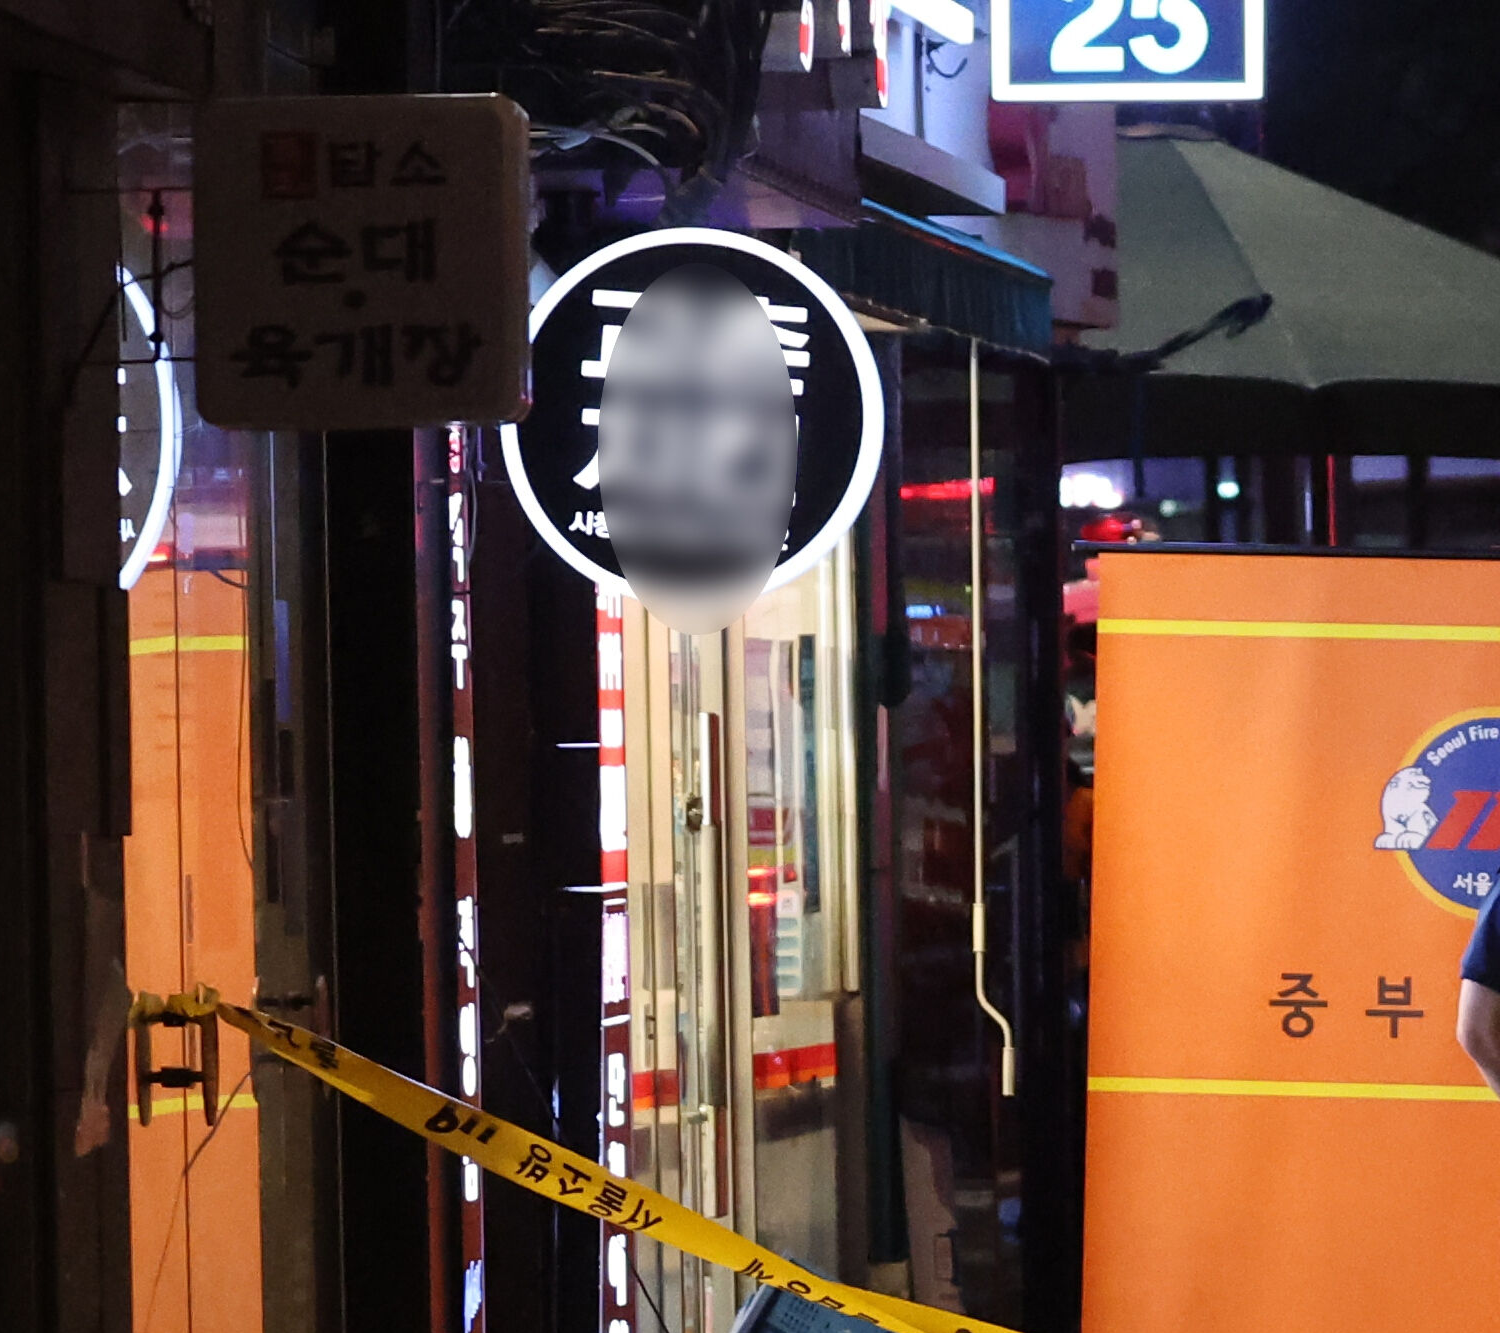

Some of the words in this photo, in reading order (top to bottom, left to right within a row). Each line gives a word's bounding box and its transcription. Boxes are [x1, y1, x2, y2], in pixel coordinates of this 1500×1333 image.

[1050, 0, 1209, 75] 25
[275, 217, 438, 284] 순대
[231, 323, 482, 388] 육개장
[1427, 730, 1467, 767] Seoul
[1468, 724, 1499, 744] Fire
